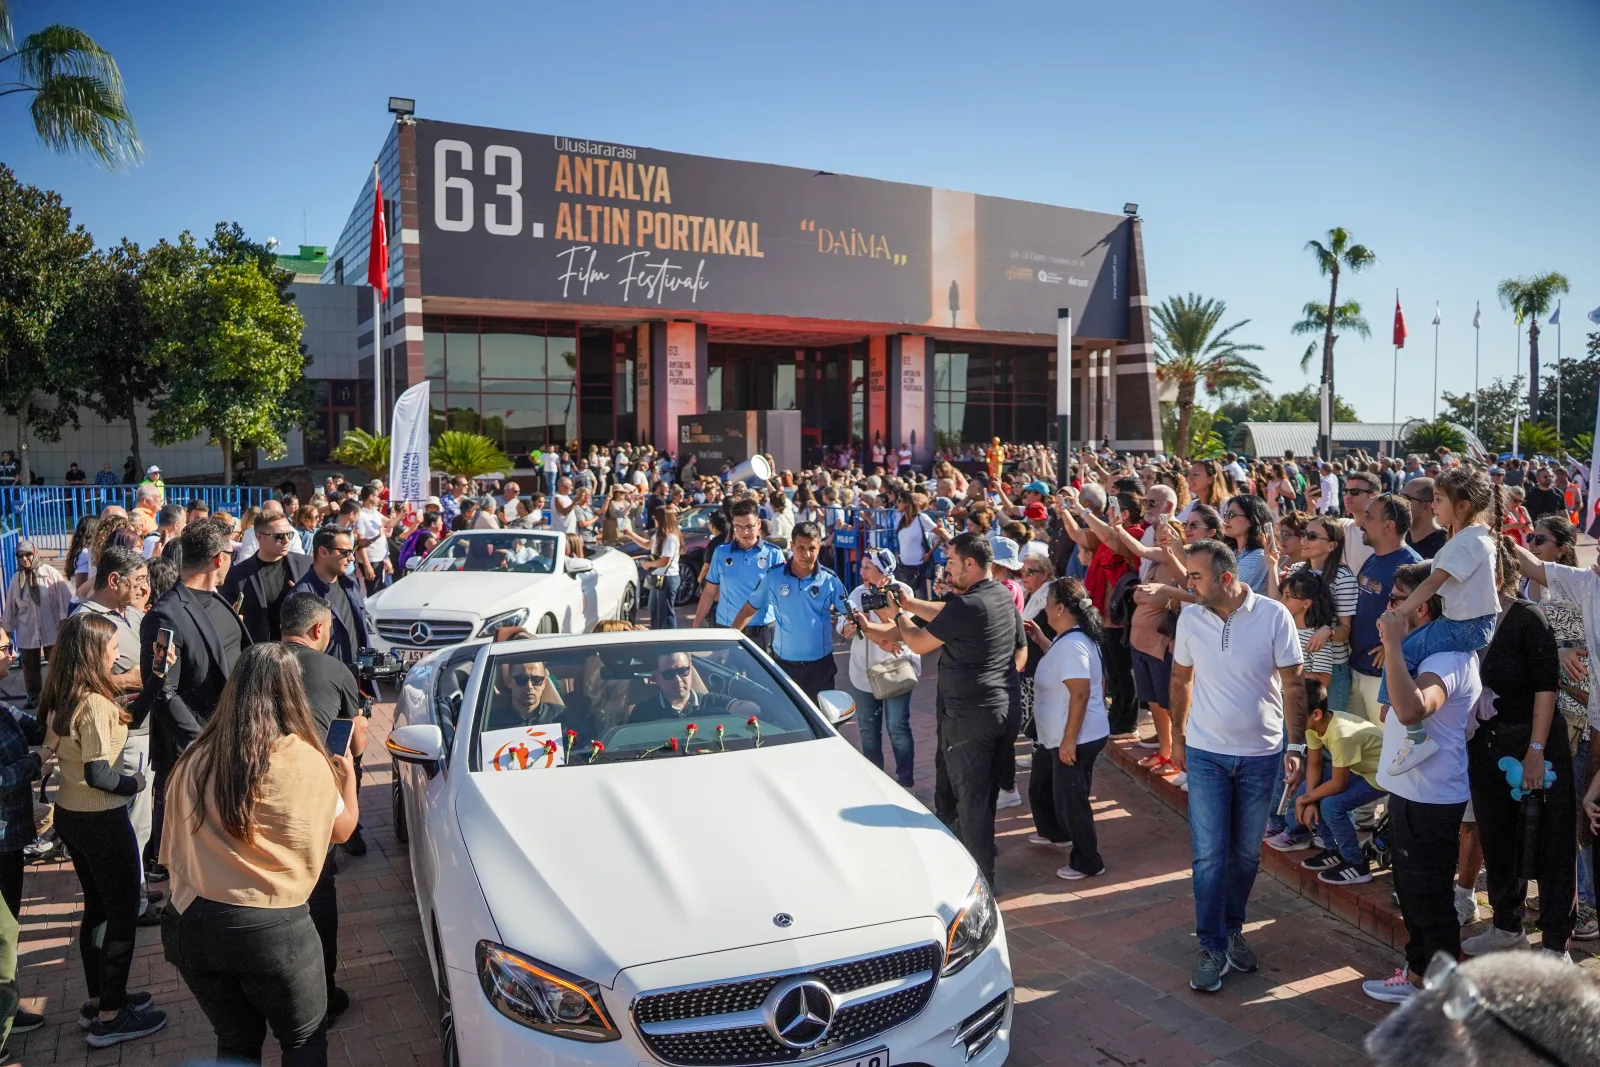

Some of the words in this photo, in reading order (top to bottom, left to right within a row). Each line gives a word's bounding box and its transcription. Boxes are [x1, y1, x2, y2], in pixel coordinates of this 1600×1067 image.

[554, 136, 636, 160] Uluslararası
[434, 139, 544, 238] 63.
[555, 154, 672, 204] ANTALYA
[555, 202, 630, 247] ALTIN
[636, 210, 765, 258] PORTAKAL
[556, 245, 610, 298] Film
[617, 251, 709, 304] Festivali
[669, 361, 691, 369] ANTALYA
